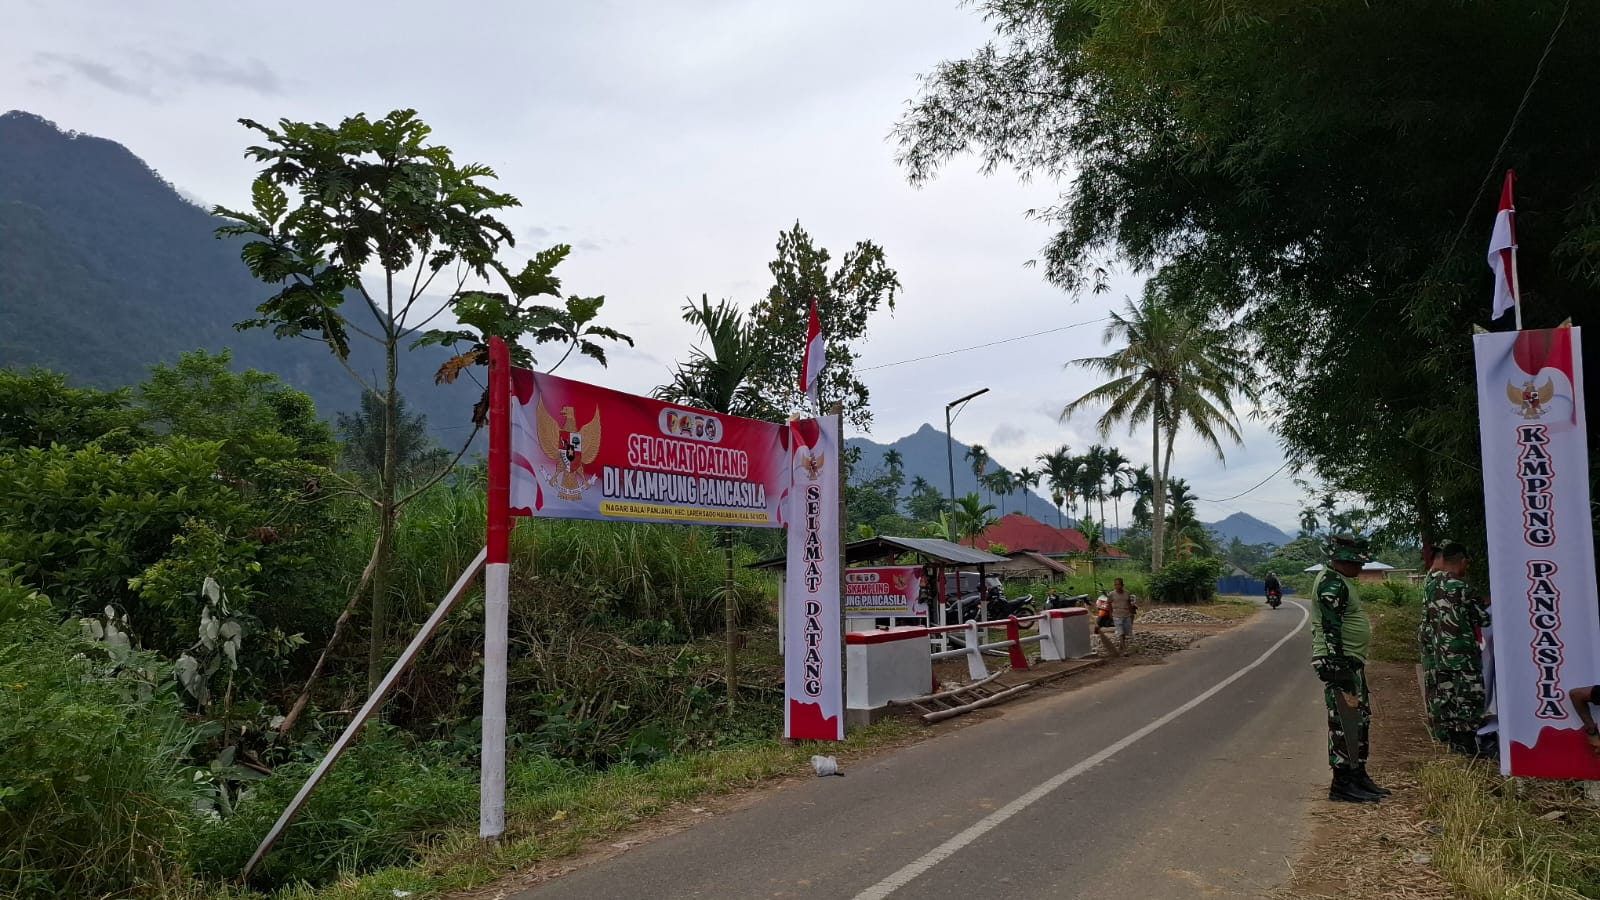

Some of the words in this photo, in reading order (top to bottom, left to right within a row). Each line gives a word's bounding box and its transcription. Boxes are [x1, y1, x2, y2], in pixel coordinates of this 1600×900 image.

[603, 466, 620, 497] DI
[623, 468, 697, 503] KAMPUNG
[699, 477, 767, 509] PANCASILA
[628, 433, 696, 472] SELAMAT
[697, 445, 748, 479] DATANG
[1516, 424, 1556, 548] KAMPUNG
[803, 483, 823, 593] SELAMAT
[803, 599, 822, 697] DATANG
[861, 594, 907, 606] PANCASILA
[1526, 559, 1569, 720] PANCASILA
